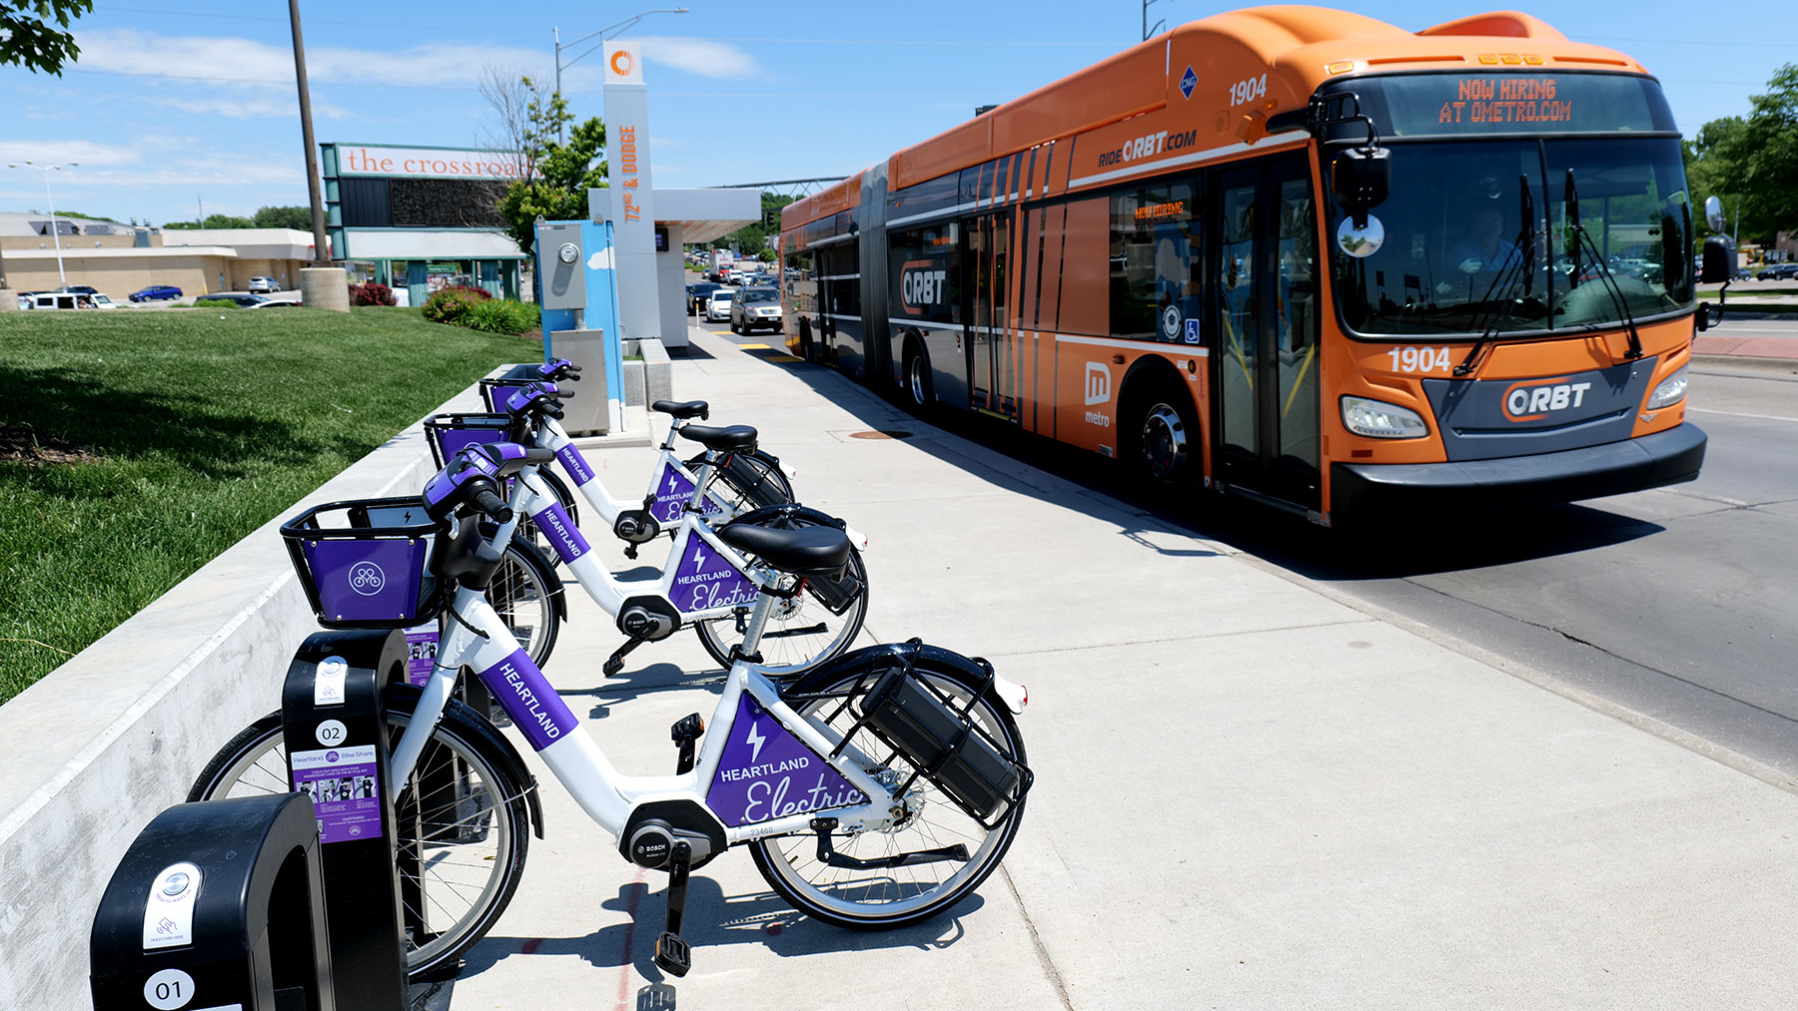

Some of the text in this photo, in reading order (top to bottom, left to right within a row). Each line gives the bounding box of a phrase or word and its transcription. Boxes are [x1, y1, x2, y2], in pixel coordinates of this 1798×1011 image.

[1181, 77, 1196, 89] CNG
[1229, 73, 1267, 107] 1904
[1458, 78, 1557, 100] NOW HIRING
[1439, 100, 1572, 123] AT OMETRO.COM
[348, 148, 394, 172] the
[619, 125, 638, 173] DODGE
[623, 178, 639, 189] &
[903, 270, 946, 305] ORBT
[1388, 346, 1451, 373] 1904
[1507, 382, 1592, 416] ORBT
[1085, 411, 1110, 428] metro
[561, 447, 589, 483] HEARTLAND
[657, 491, 695, 503] HEARTLAN
[544, 509, 582, 557] HEARTLAND
[677, 569, 732, 585] HEARTLAND
[500, 662, 561, 739] HEARTLAND
[322, 727, 340, 740] 02
[721, 756, 810, 782] HEARTLAND
[744, 772, 864, 824] Electric
[155, 981, 181, 1000] 01
